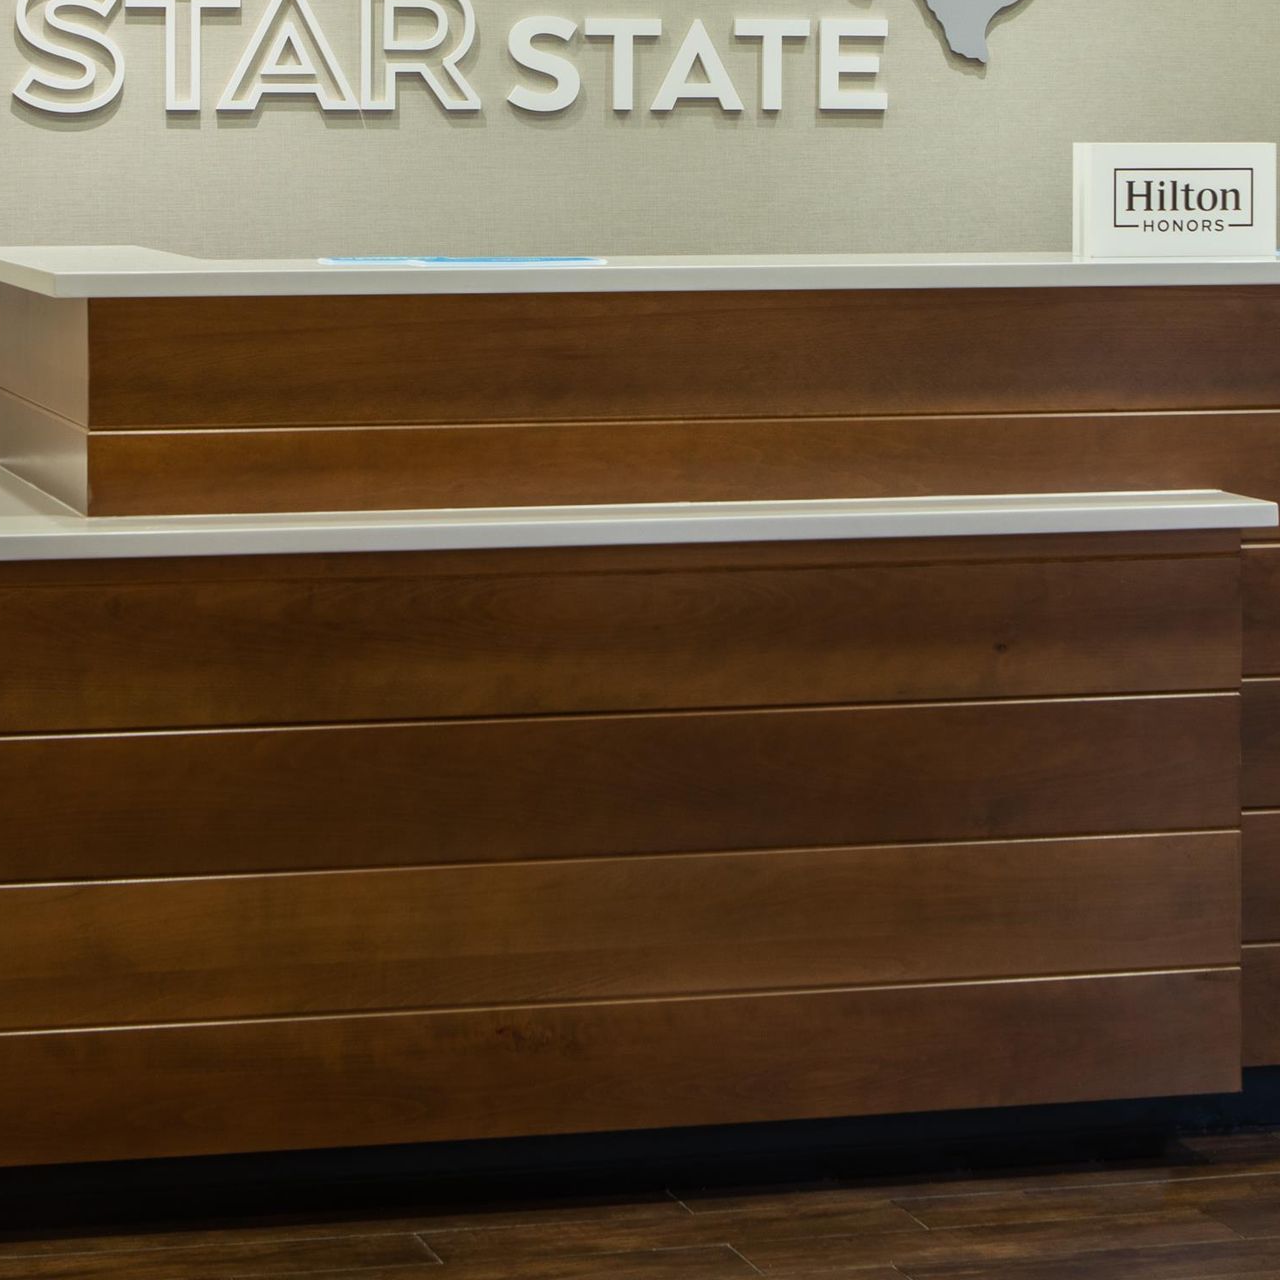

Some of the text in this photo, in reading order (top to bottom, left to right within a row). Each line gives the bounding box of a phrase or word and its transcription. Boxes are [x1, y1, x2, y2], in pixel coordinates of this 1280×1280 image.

[505, 15, 888, 112] STATE
[1125, 180, 1242, 212] Hilton
[1143, 219, 1225, 232] HONORS
